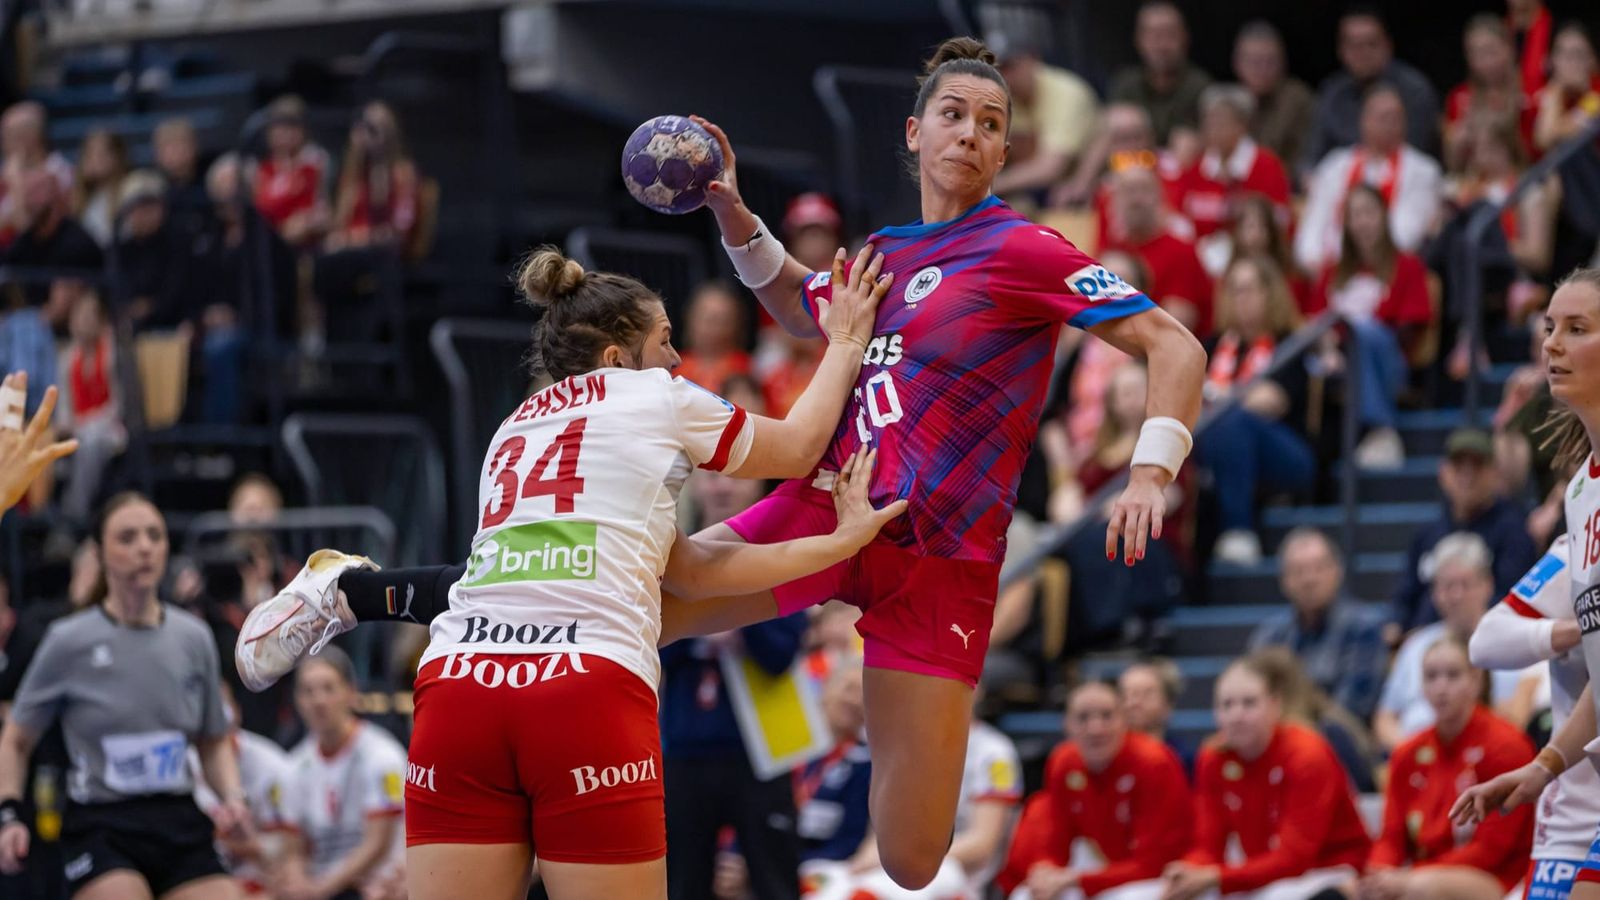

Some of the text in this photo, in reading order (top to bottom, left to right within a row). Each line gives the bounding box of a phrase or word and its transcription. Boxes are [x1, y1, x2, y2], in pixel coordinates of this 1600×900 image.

[482, 416, 588, 530] 34
[500, 542, 594, 577] bring
[457, 616, 581, 645] Boozt
[438, 652, 590, 689] Boozt
[569, 753, 657, 796] Boozt
